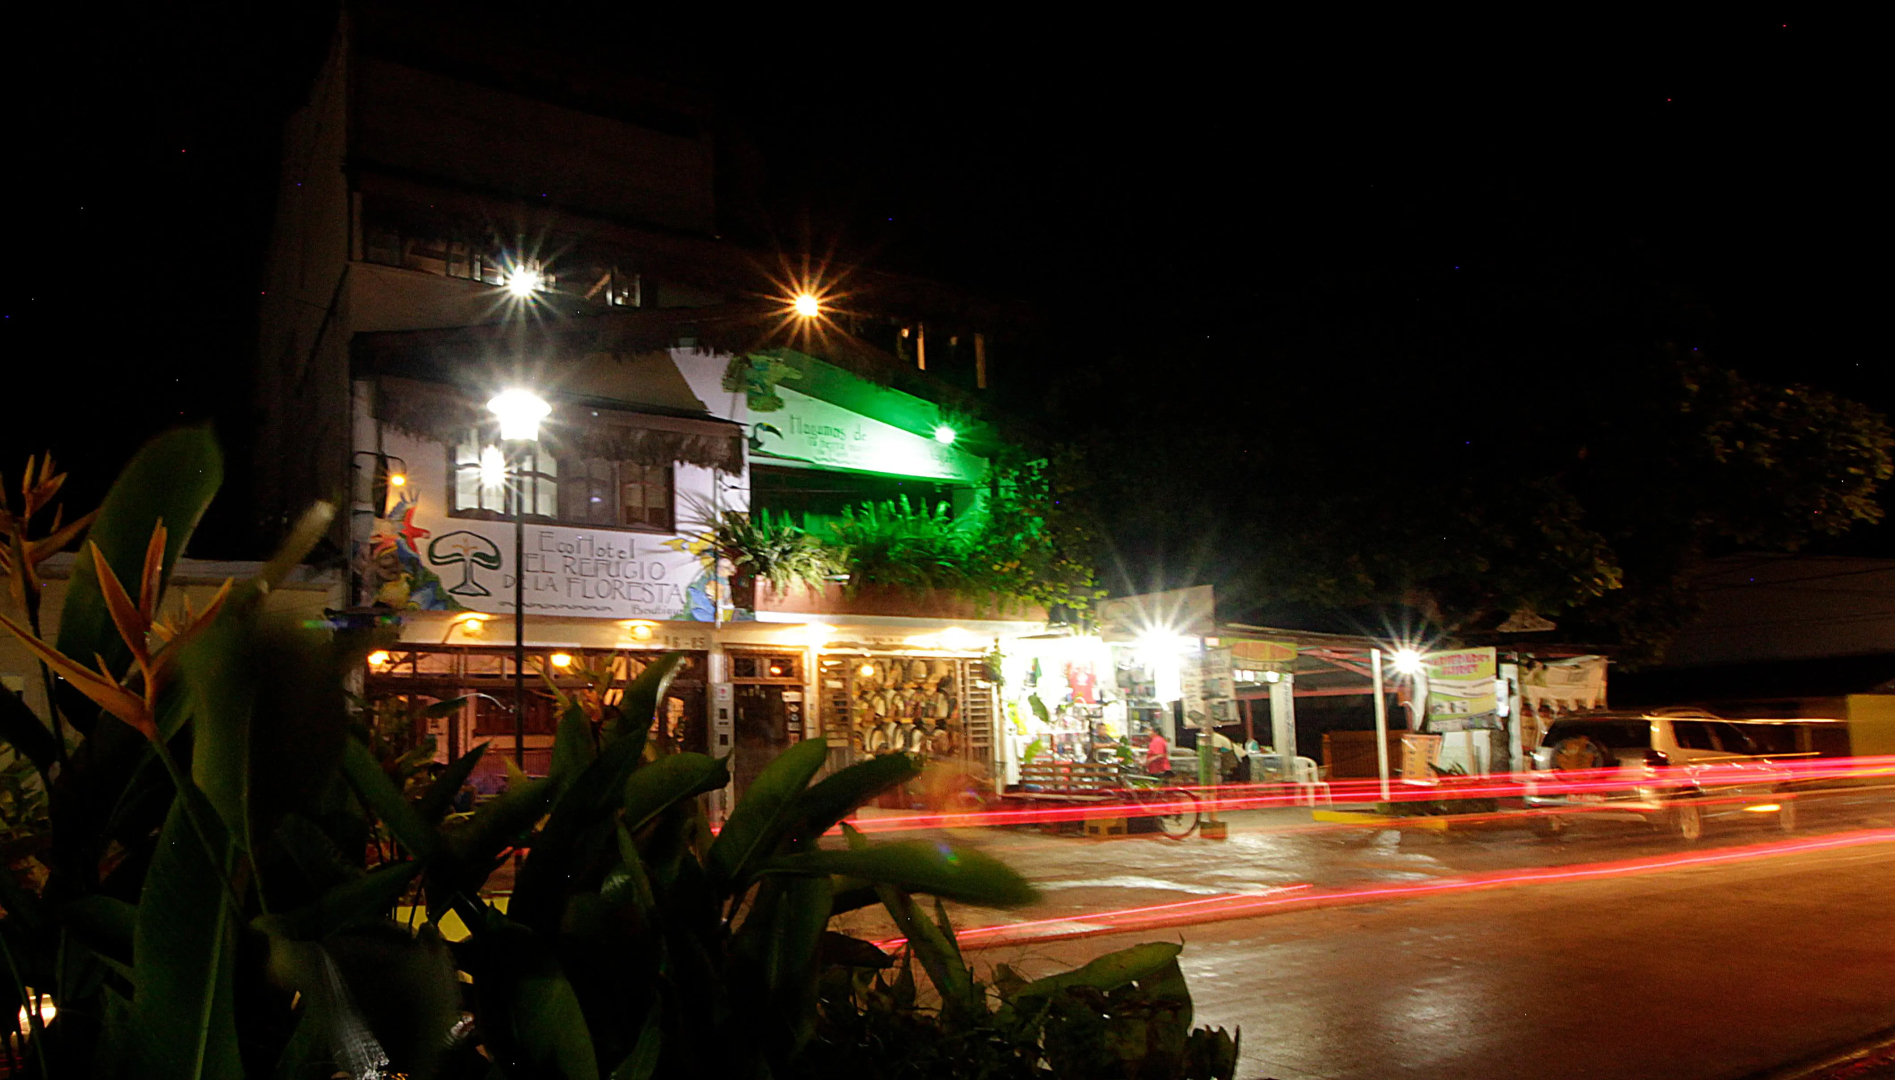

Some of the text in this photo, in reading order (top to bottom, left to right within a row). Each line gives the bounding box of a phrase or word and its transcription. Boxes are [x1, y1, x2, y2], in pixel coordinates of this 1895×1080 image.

[539, 531, 635, 559] EcoHotel
[523, 553, 666, 580] EL REFUGIO
[534, 575, 558, 592] LA
[566, 577, 685, 604] FLORESTA
